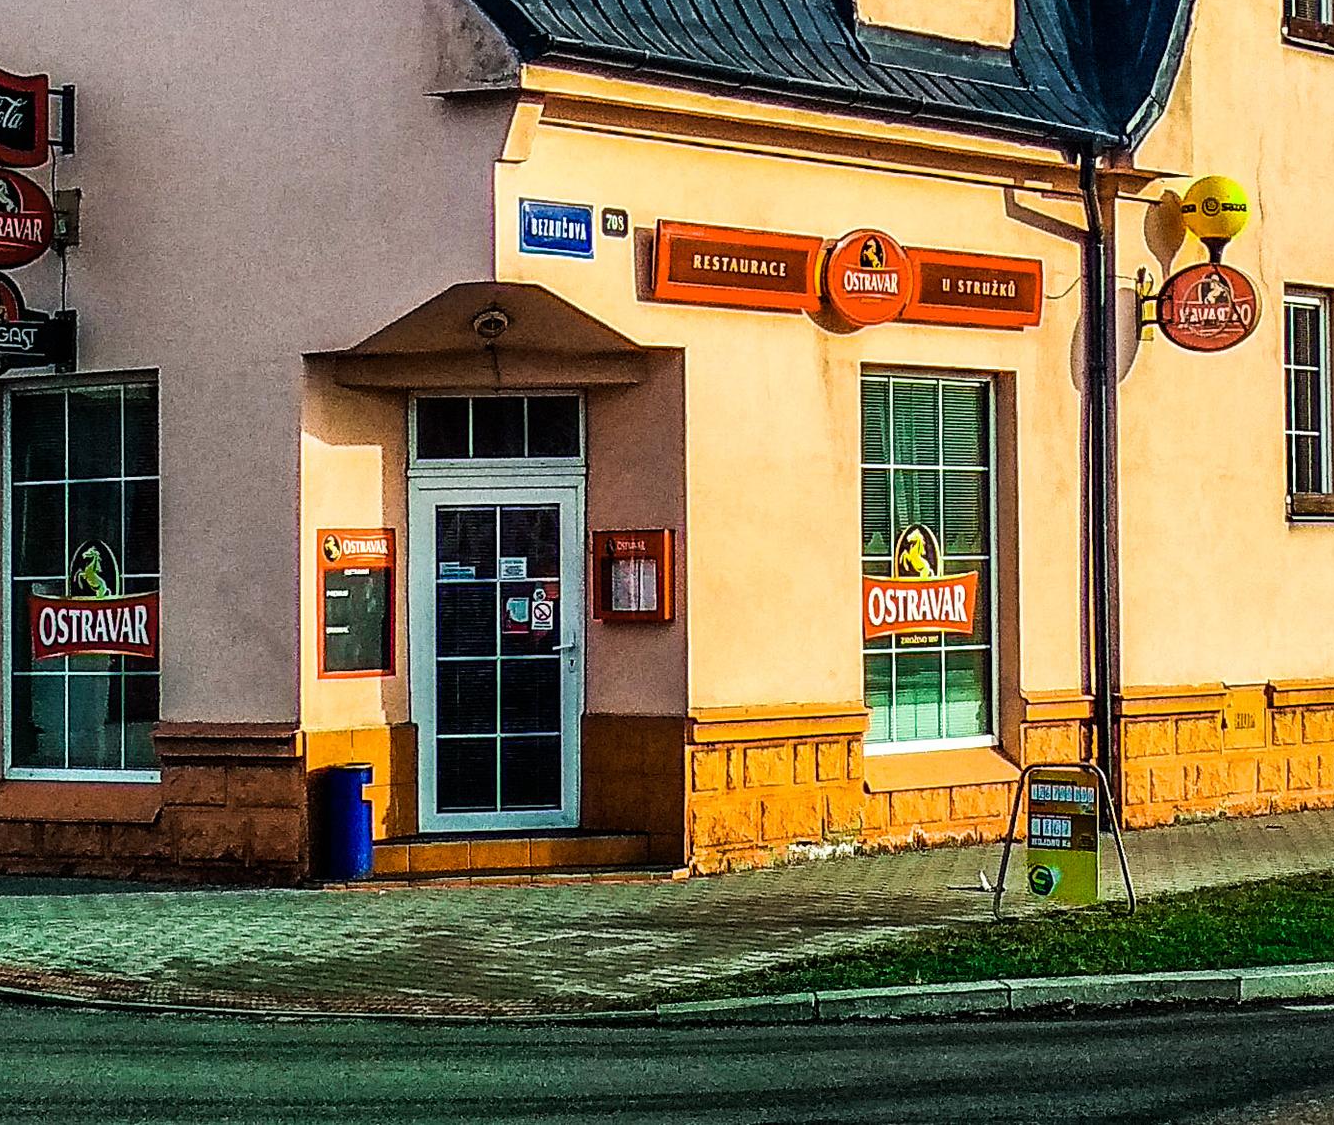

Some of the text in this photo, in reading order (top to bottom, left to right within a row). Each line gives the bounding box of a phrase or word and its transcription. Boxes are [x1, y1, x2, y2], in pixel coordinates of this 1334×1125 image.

[531, 217, 587, 241] BEZRUČOVA
[693, 254, 787, 277] RESTAURACE
[843, 270, 899, 294] OSTRAVAR
[942, 279, 1016, 298] U STRUŽKŮ
[342, 539, 389, 555] OSTRAVAR
[868, 584, 968, 626] OSTRAVAR
[39, 605, 150, 646] OSTRAVAR
